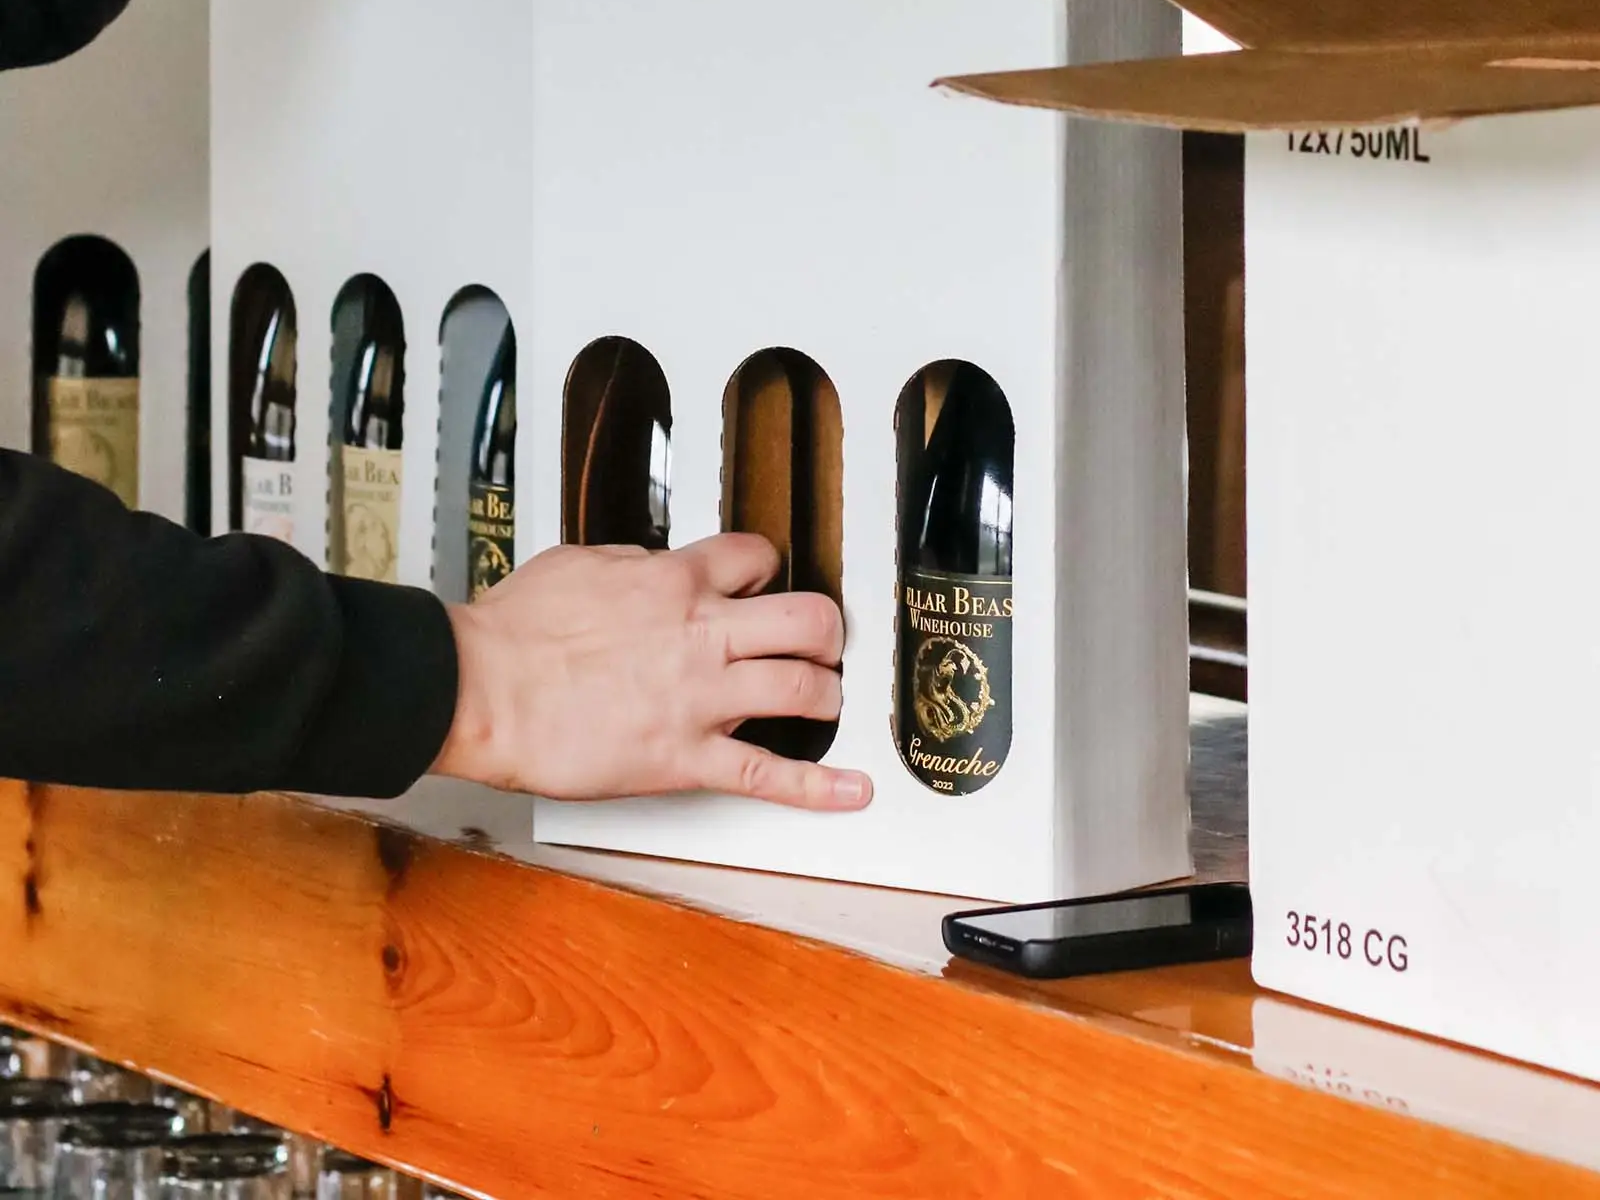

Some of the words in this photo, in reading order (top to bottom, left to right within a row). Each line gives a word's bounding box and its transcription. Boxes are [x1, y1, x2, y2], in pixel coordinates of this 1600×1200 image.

[906, 586, 948, 613] ELLAR
[953, 586, 1012, 618] BEAS
[910, 606, 993, 638] WINEHOUSE
[909, 733, 1000, 776] Grenache
[932, 779, 954, 791] 2022
[1286, 911, 1351, 960] 3518
[1364, 929, 1408, 972] CG
